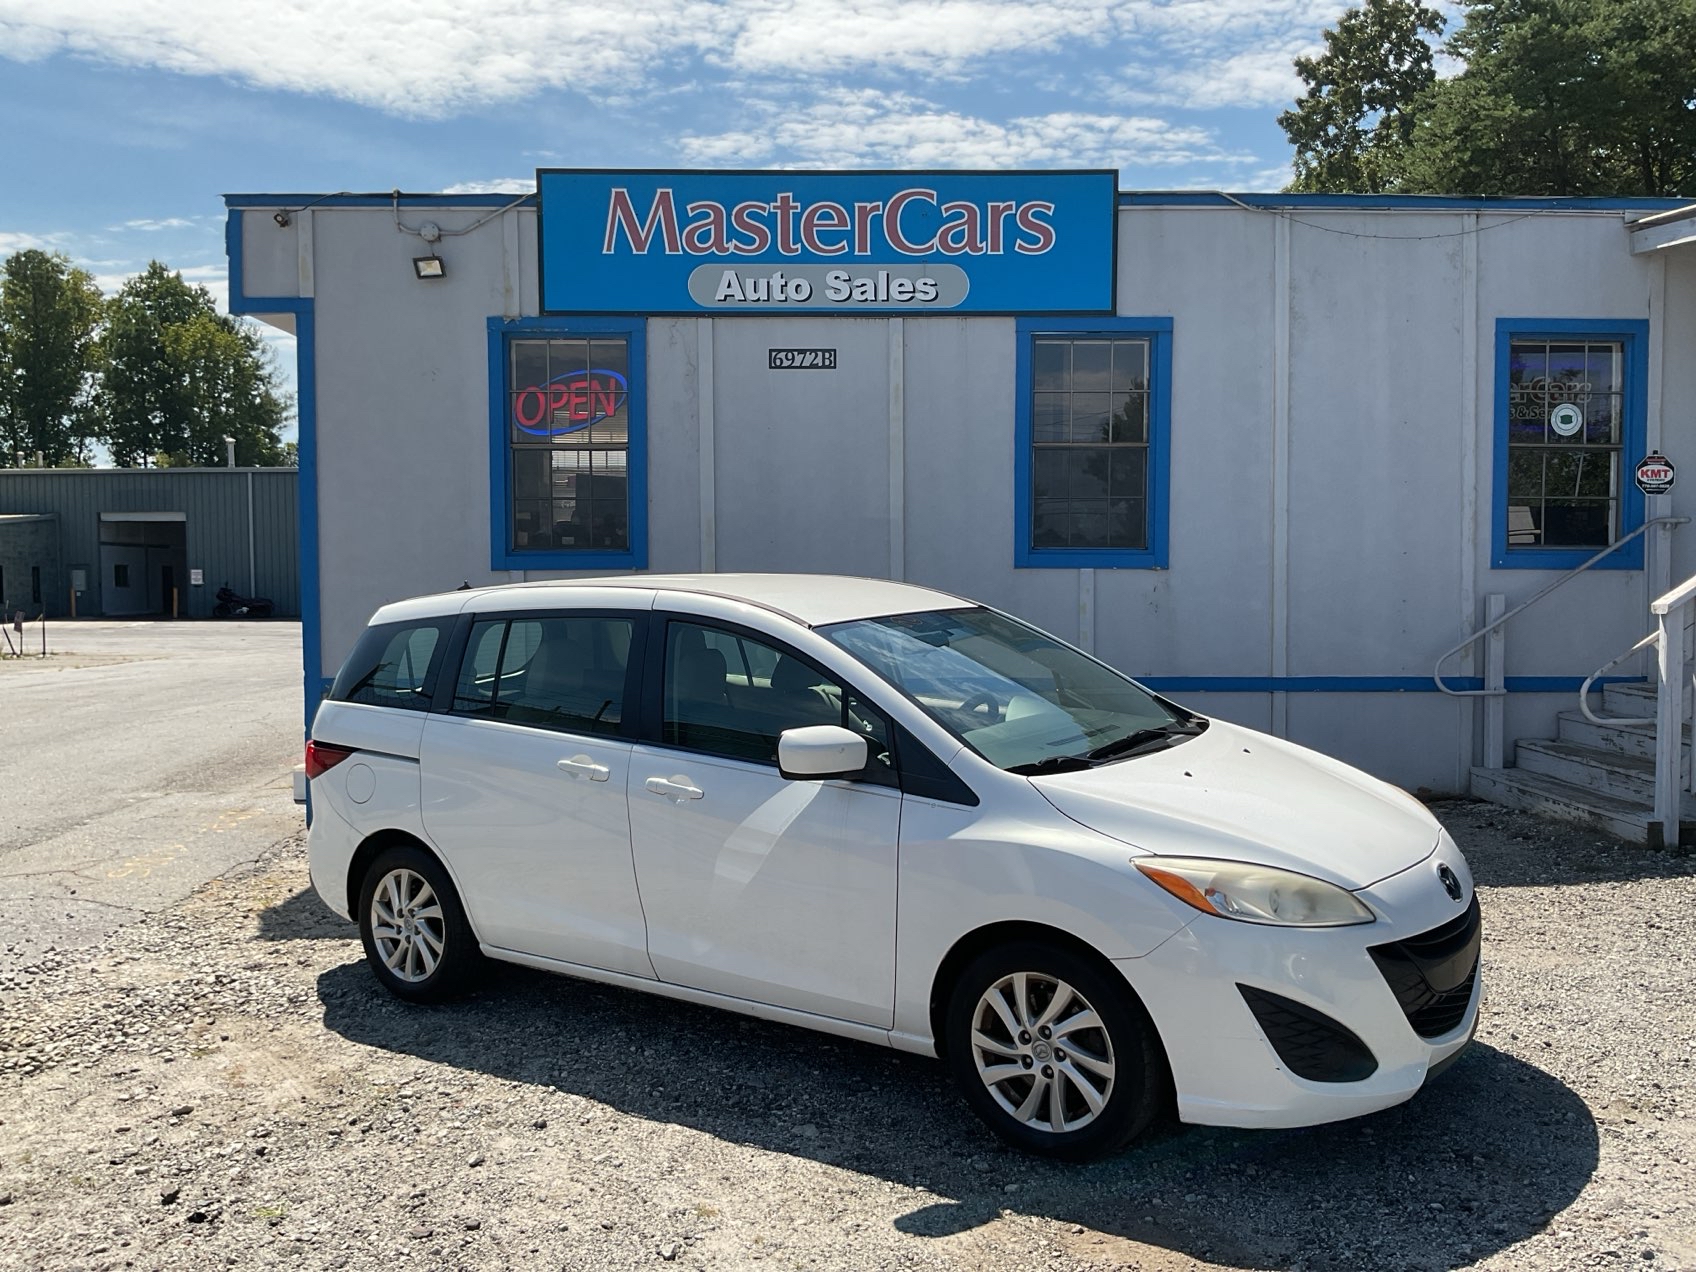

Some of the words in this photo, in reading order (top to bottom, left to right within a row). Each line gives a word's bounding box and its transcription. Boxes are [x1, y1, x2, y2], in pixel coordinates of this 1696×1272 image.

[601, 187, 1056, 256] MasterCars
[715, 270, 812, 303] Auto
[824, 270, 939, 303] Sales
[771, 351, 834, 368] 6972B
[515, 377, 617, 427] OPEN
[1640, 469, 1671, 479] KMT
